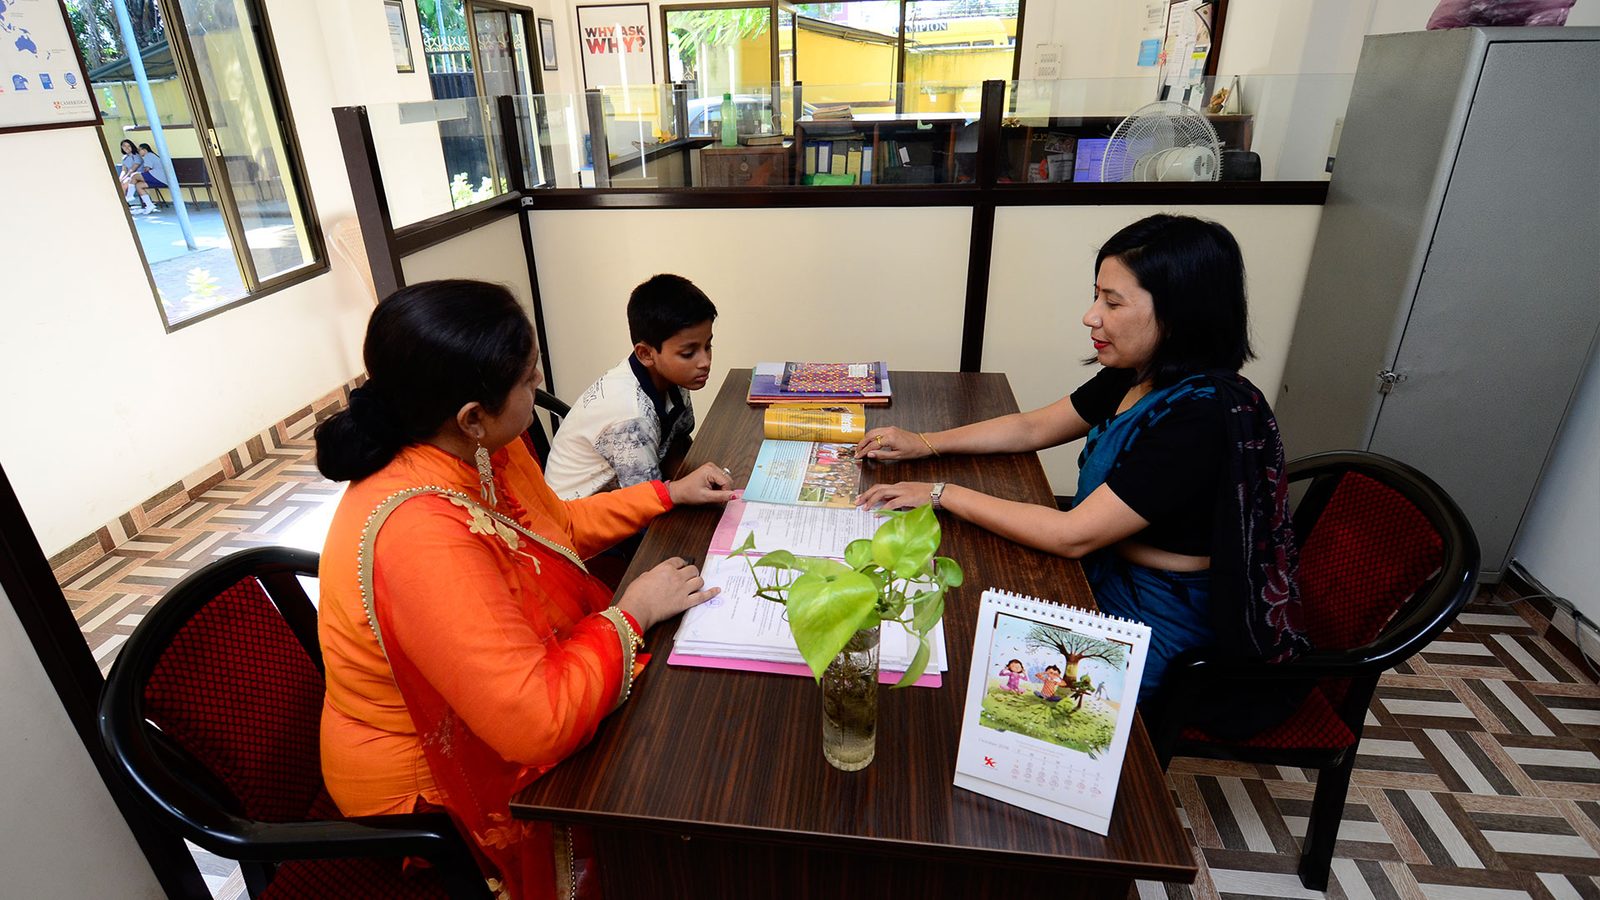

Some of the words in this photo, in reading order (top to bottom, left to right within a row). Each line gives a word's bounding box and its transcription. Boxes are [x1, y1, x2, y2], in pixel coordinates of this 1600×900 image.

[585, 26, 615, 38] WHY
[621, 25, 645, 36] ASK
[586, 36, 646, 54] WHY?
